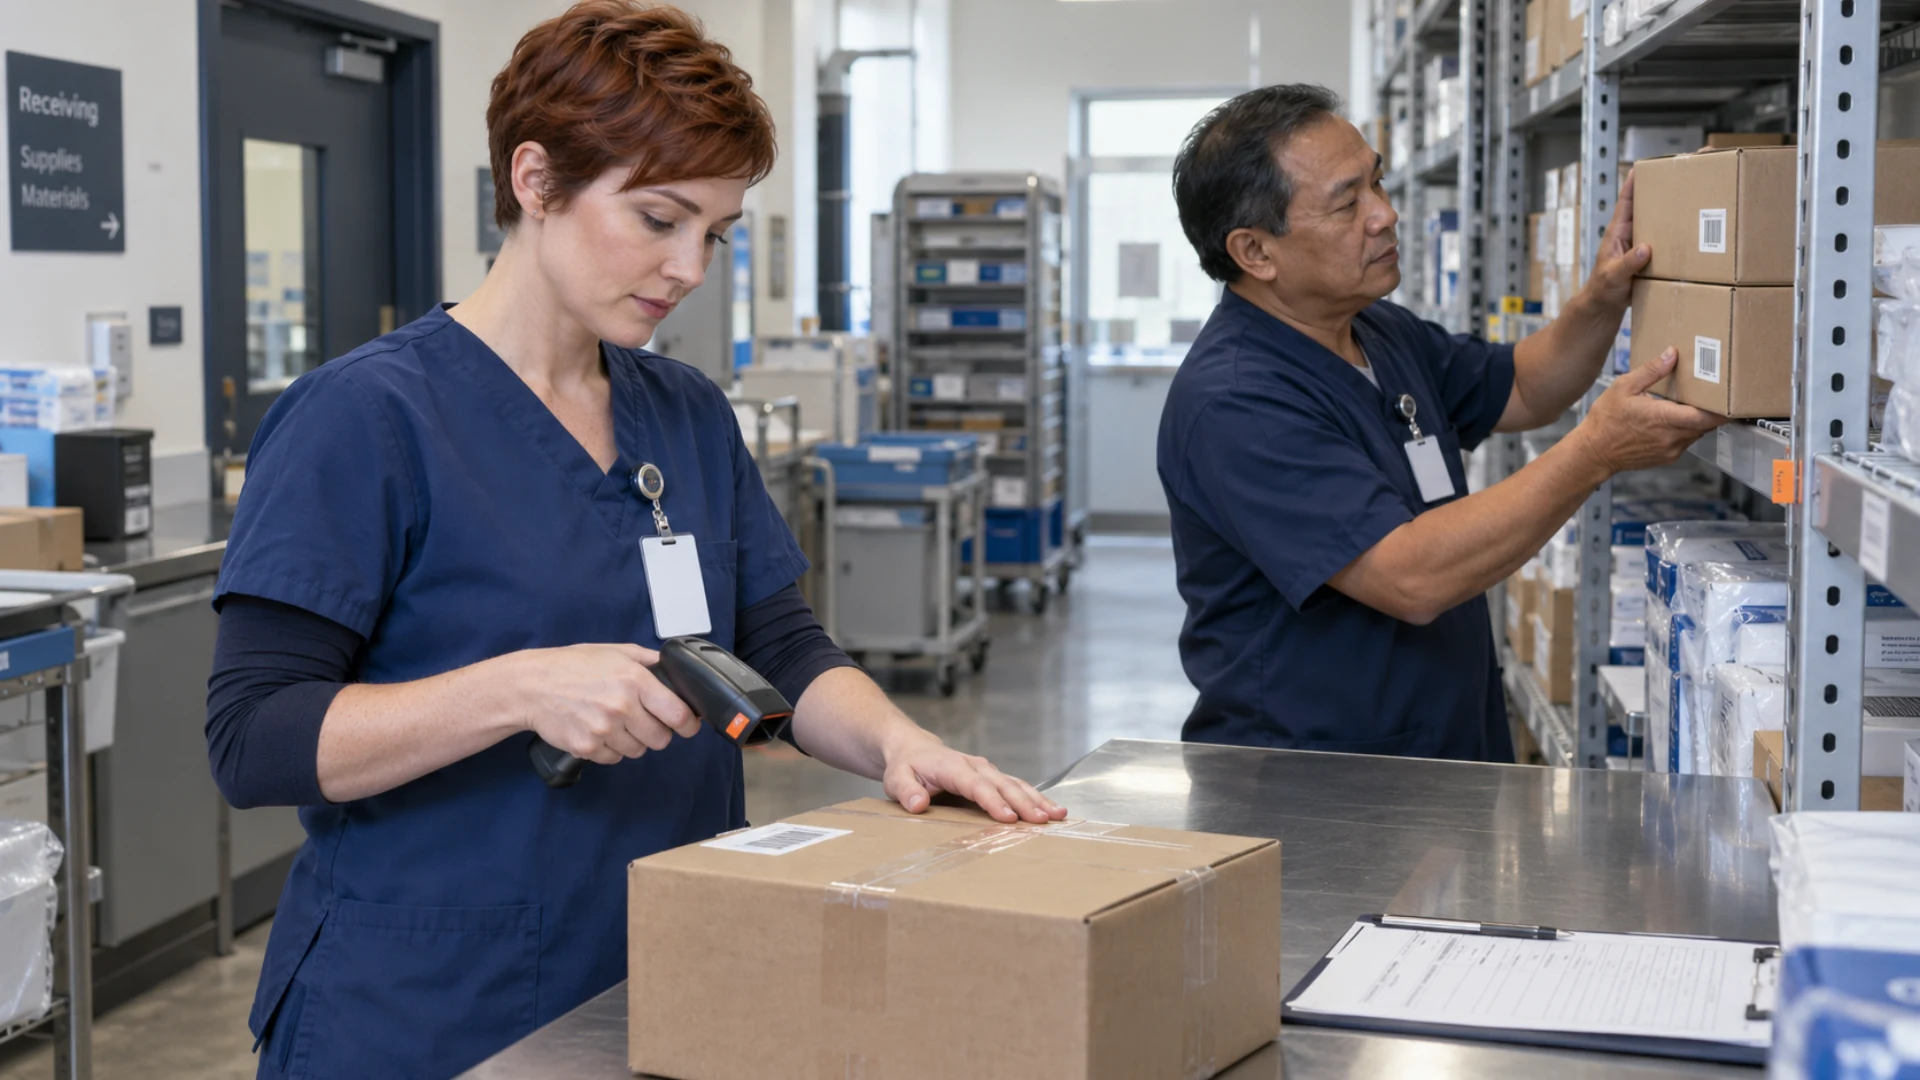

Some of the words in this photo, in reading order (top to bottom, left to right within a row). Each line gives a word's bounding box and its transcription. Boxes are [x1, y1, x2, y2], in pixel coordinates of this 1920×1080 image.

[19, 86, 99, 127] Receiving
[21, 145, 82, 174] Supplies
[22, 183, 89, 210] Materials
